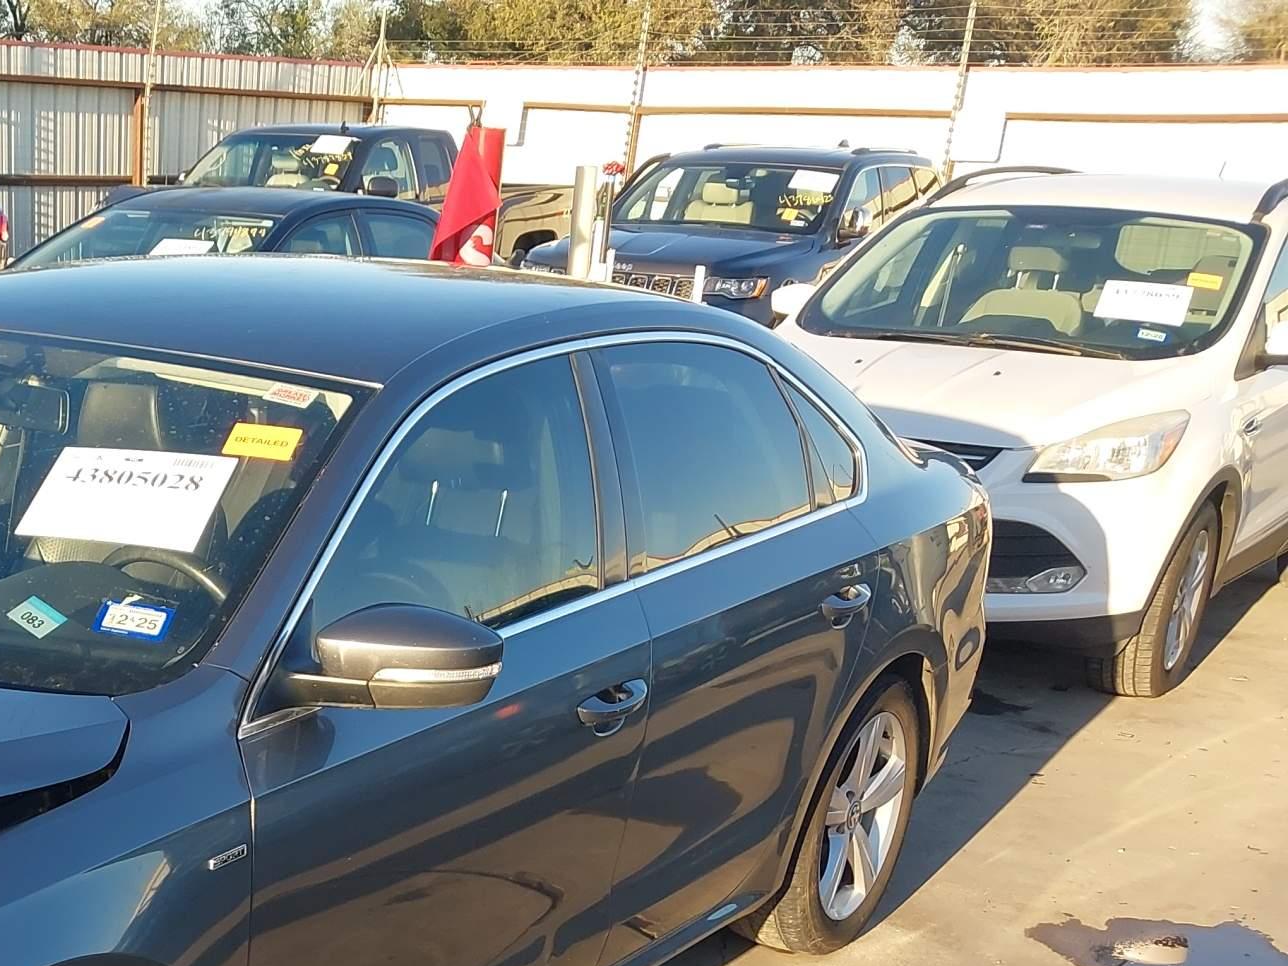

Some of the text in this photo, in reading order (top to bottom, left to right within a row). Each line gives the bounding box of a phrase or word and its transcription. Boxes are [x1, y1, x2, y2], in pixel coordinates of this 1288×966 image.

[234, 435, 289, 448] DETAILED
[65, 466, 204, 492] 43805028
[20, 610, 45, 629] 083
